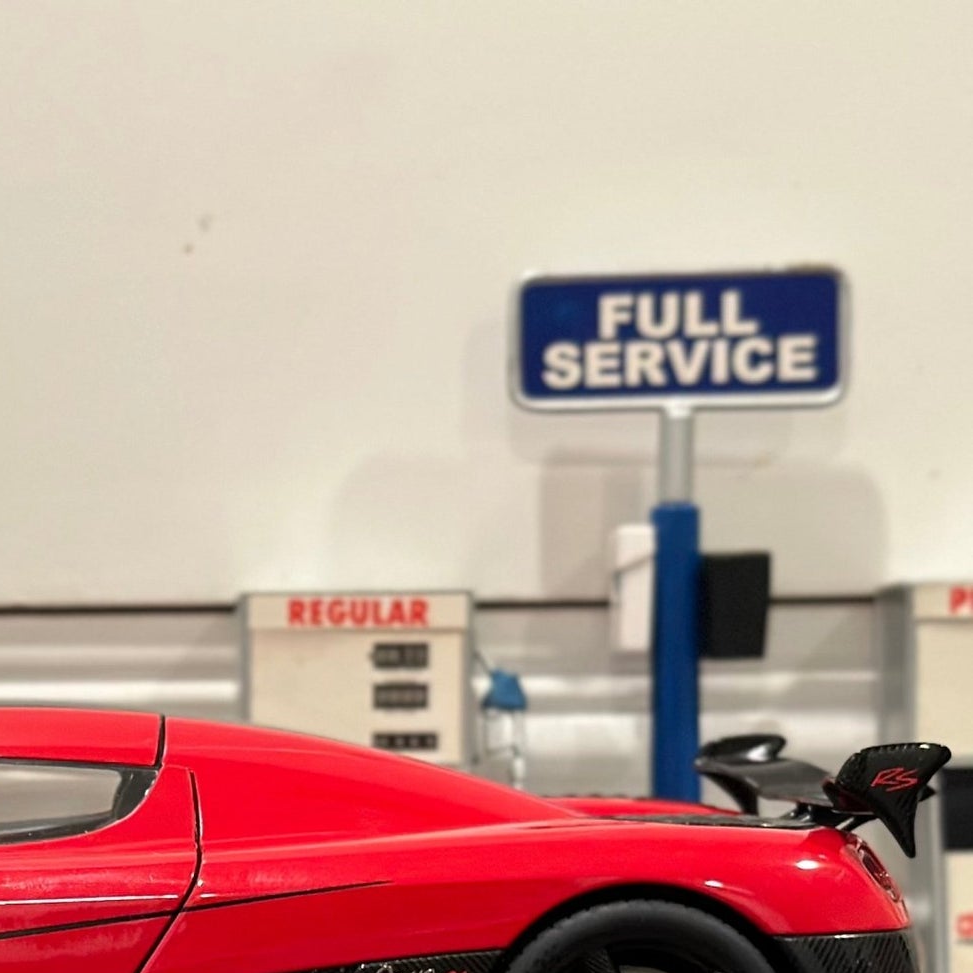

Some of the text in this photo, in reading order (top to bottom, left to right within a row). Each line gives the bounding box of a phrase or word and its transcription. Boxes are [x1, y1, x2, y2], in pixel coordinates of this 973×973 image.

[597, 290, 760, 340] FULL
[541, 334, 818, 389] SERVICE
[288, 598, 429, 626] REGULAR
[949, 586, 973, 615] P
[871, 767, 920, 792] RS
